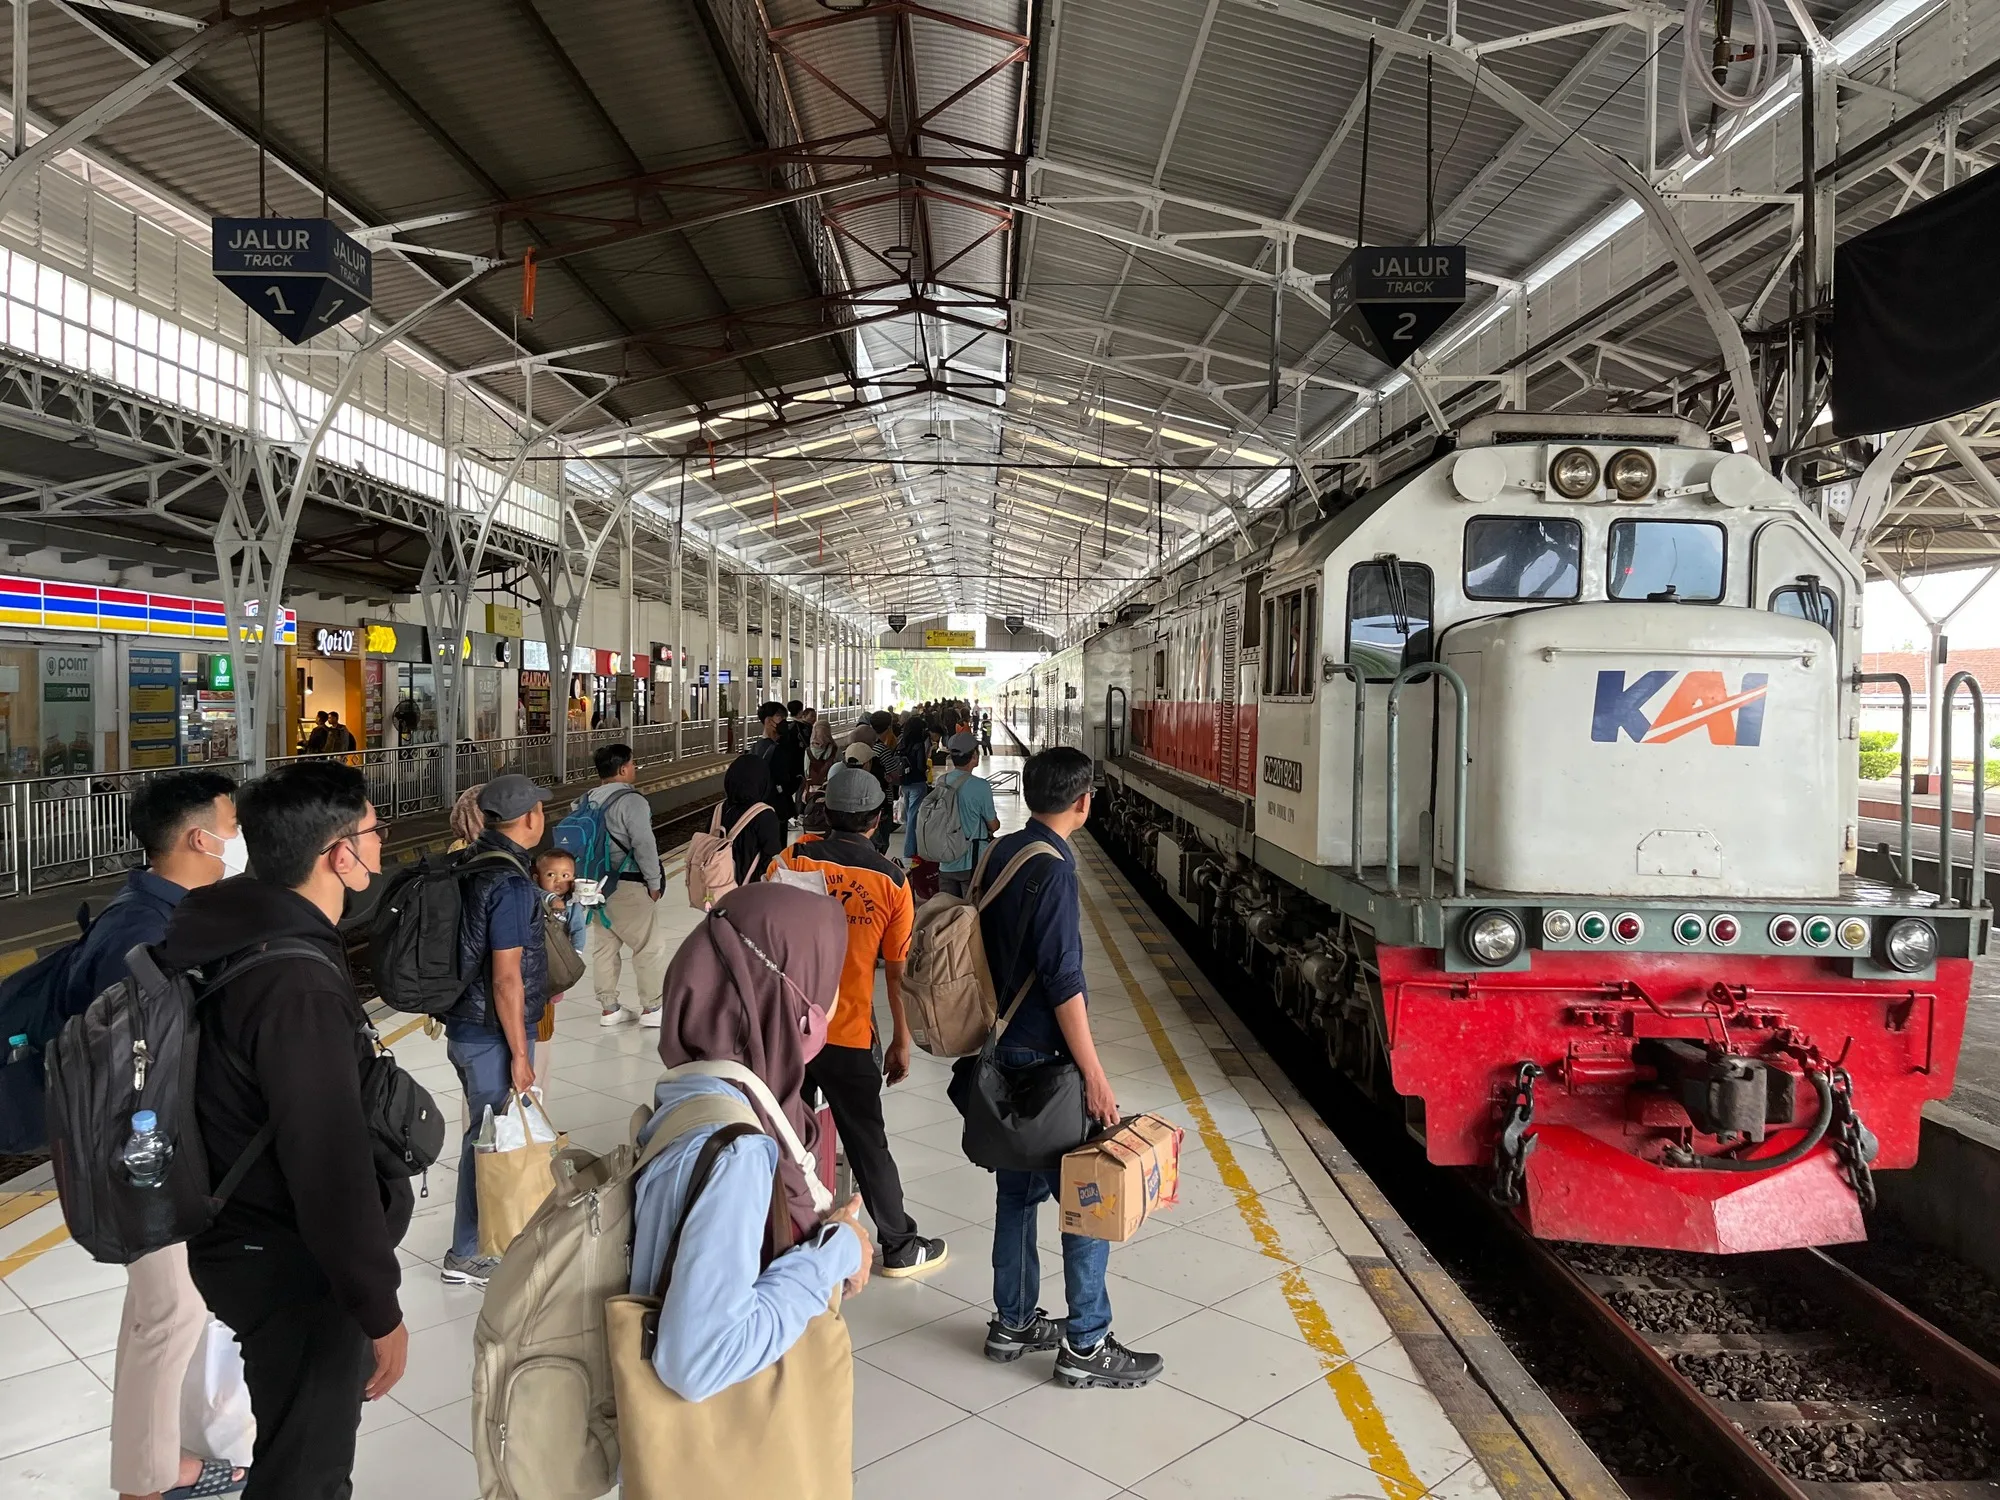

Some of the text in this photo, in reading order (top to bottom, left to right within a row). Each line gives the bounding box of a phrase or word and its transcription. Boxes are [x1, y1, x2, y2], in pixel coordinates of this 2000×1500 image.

[228, 229, 310, 250] JALUR
[244, 254, 294, 267] TRACK
[333, 238, 367, 275] JALUR
[1371, 256, 1450, 277] JALUR
[340, 264, 361, 288] TRACK
[1386, 281, 1434, 293] TRACK
[264, 285, 296, 315] 1
[318, 298, 344, 324] 1
[1392, 312, 1417, 341] 2
[66, 687, 89, 698] SAKU
[1591, 670, 1769, 747] KAI
[849, 880, 875, 913] BESAR
